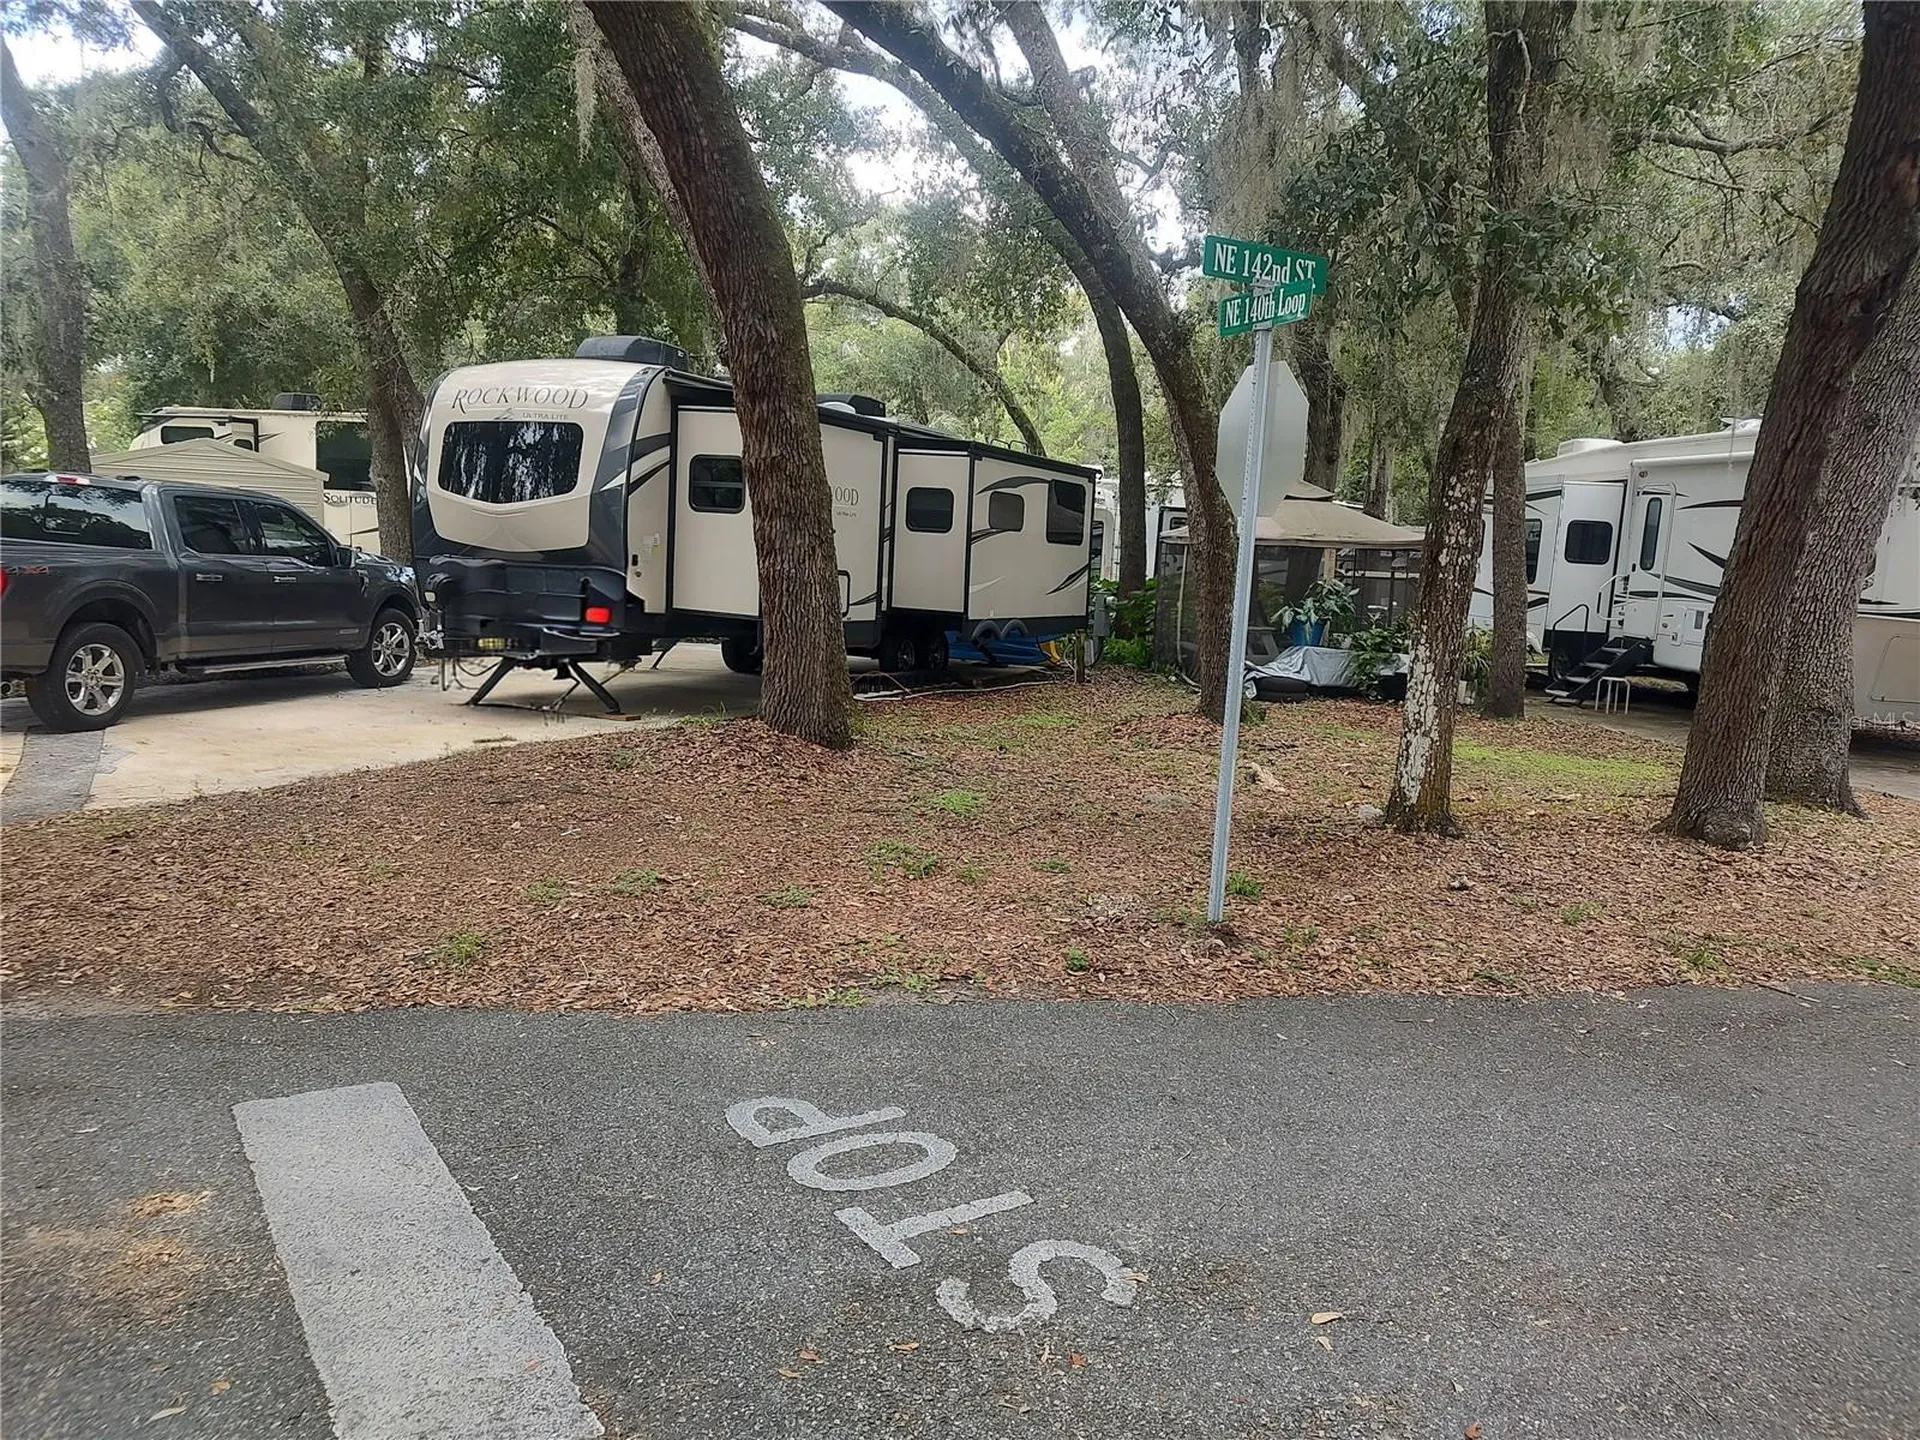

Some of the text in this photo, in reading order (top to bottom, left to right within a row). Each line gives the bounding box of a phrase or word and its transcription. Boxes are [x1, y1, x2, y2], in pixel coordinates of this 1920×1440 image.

[1214, 243, 1237, 274] NE
[1242, 250, 1291, 284] 142nd
[1225, 288, 1306, 328] NE 140th Loop
[451, 387, 589, 414] ROCKWOOD
[323, 492, 377, 505] SOLITUDE
[725, 1096, 1149, 1333] STOP
